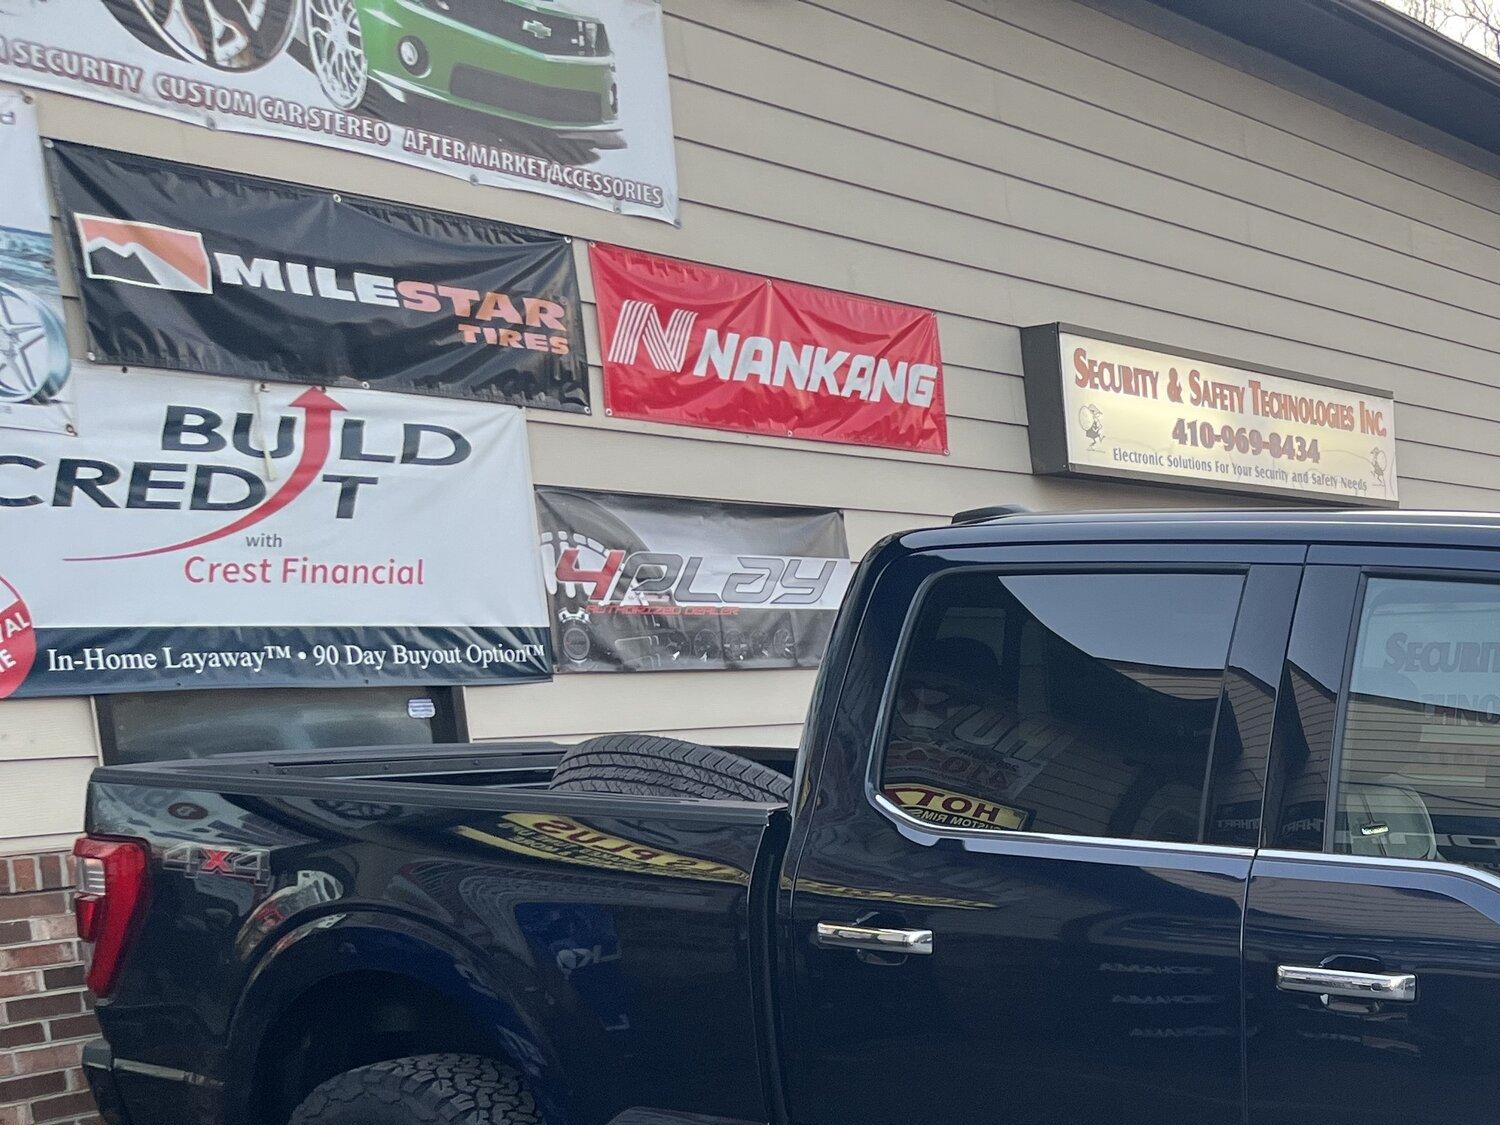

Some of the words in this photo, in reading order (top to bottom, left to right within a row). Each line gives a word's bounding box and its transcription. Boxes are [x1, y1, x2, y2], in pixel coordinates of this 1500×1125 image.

[13, 39, 143, 92] SECURITY
[154, 72, 256, 118] CUSTOM
[259, 96, 306, 127] CAR
[306, 106, 390, 145] STEREO
[402, 127, 467, 162] AFTER
[467, 143, 548, 180] MARKET
[547, 163, 664, 207] ACCESSORIES
[213, 251, 567, 332] MILESTAR
[458, 323, 570, 356] TIRES
[693, 328, 938, 409] NANKANG
[1073, 347, 1159, 400] SECURITY
[1166, 367, 1183, 403] &
[1188, 368, 1246, 415] SAFETY
[1248, 379, 1354, 432] TECHNOLOGIES
[1172, 417, 1321, 464] 410-969-8434
[1112, 447, 1164, 468] Electronic
[1167, 454, 1212, 474] Solutions
[1215, 461, 1229, 475] For
[1233, 463, 1251, 478] Your
[1254, 464, 1288, 484] Security
[1292, 467, 1309, 484] and
[1311, 469, 1338, 489] Safety
[1340, 476, 1367, 491] Needs
[245, 532, 283, 549] with
[184, 555, 272, 585] Crest
[281, 556, 425, 586] Financial
[585, 604, 682, 616] AUTHORIZED
[683, 605, 742, 617] DEALER
[47, 646, 158, 673] In-Home
[313, 644, 340, 667] 90
[345, 642, 388, 671] Day
[392, 642, 462, 670] Buyout
